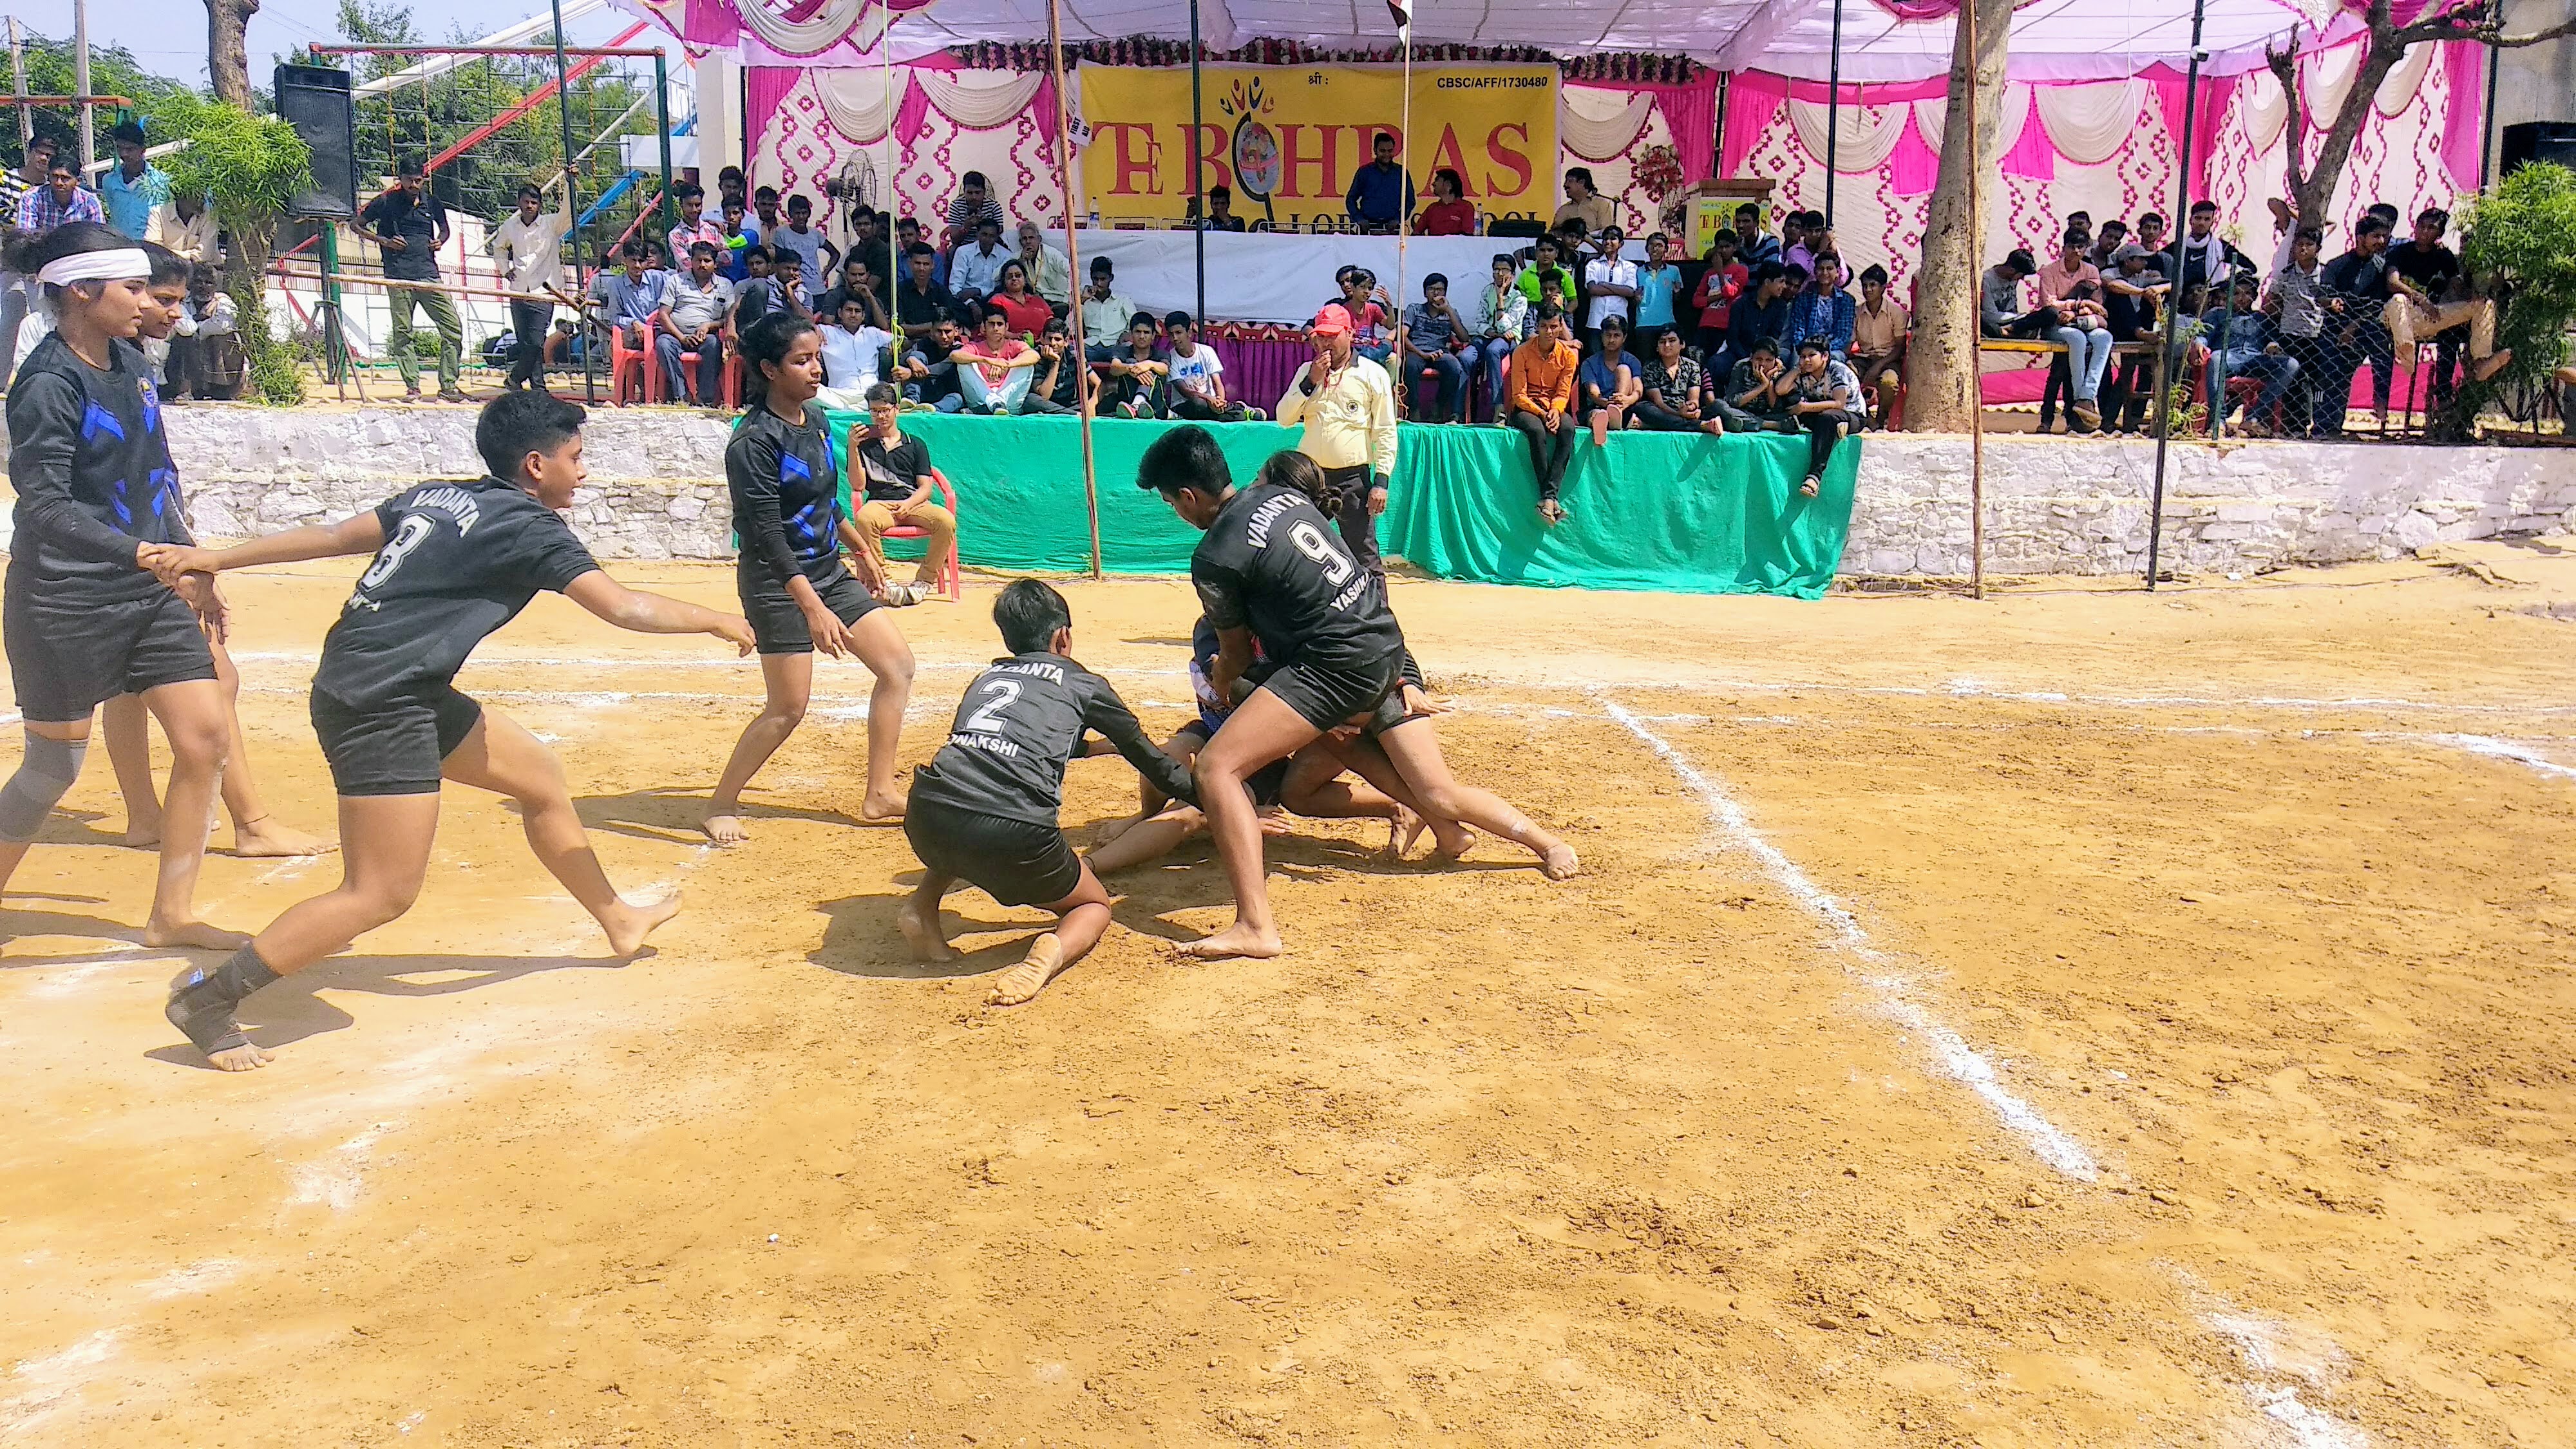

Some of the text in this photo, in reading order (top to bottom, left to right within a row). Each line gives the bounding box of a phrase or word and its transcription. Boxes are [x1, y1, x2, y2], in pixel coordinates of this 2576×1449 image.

[1070, 117, 1081, 135] FIRST
[410, 487, 480, 538] VADANTA
[1247, 493, 1309, 549] VADANTA
[357, 512, 437, 593] 8
[1286, 518, 1356, 588] 9
[963, 677, 1025, 737] 2
